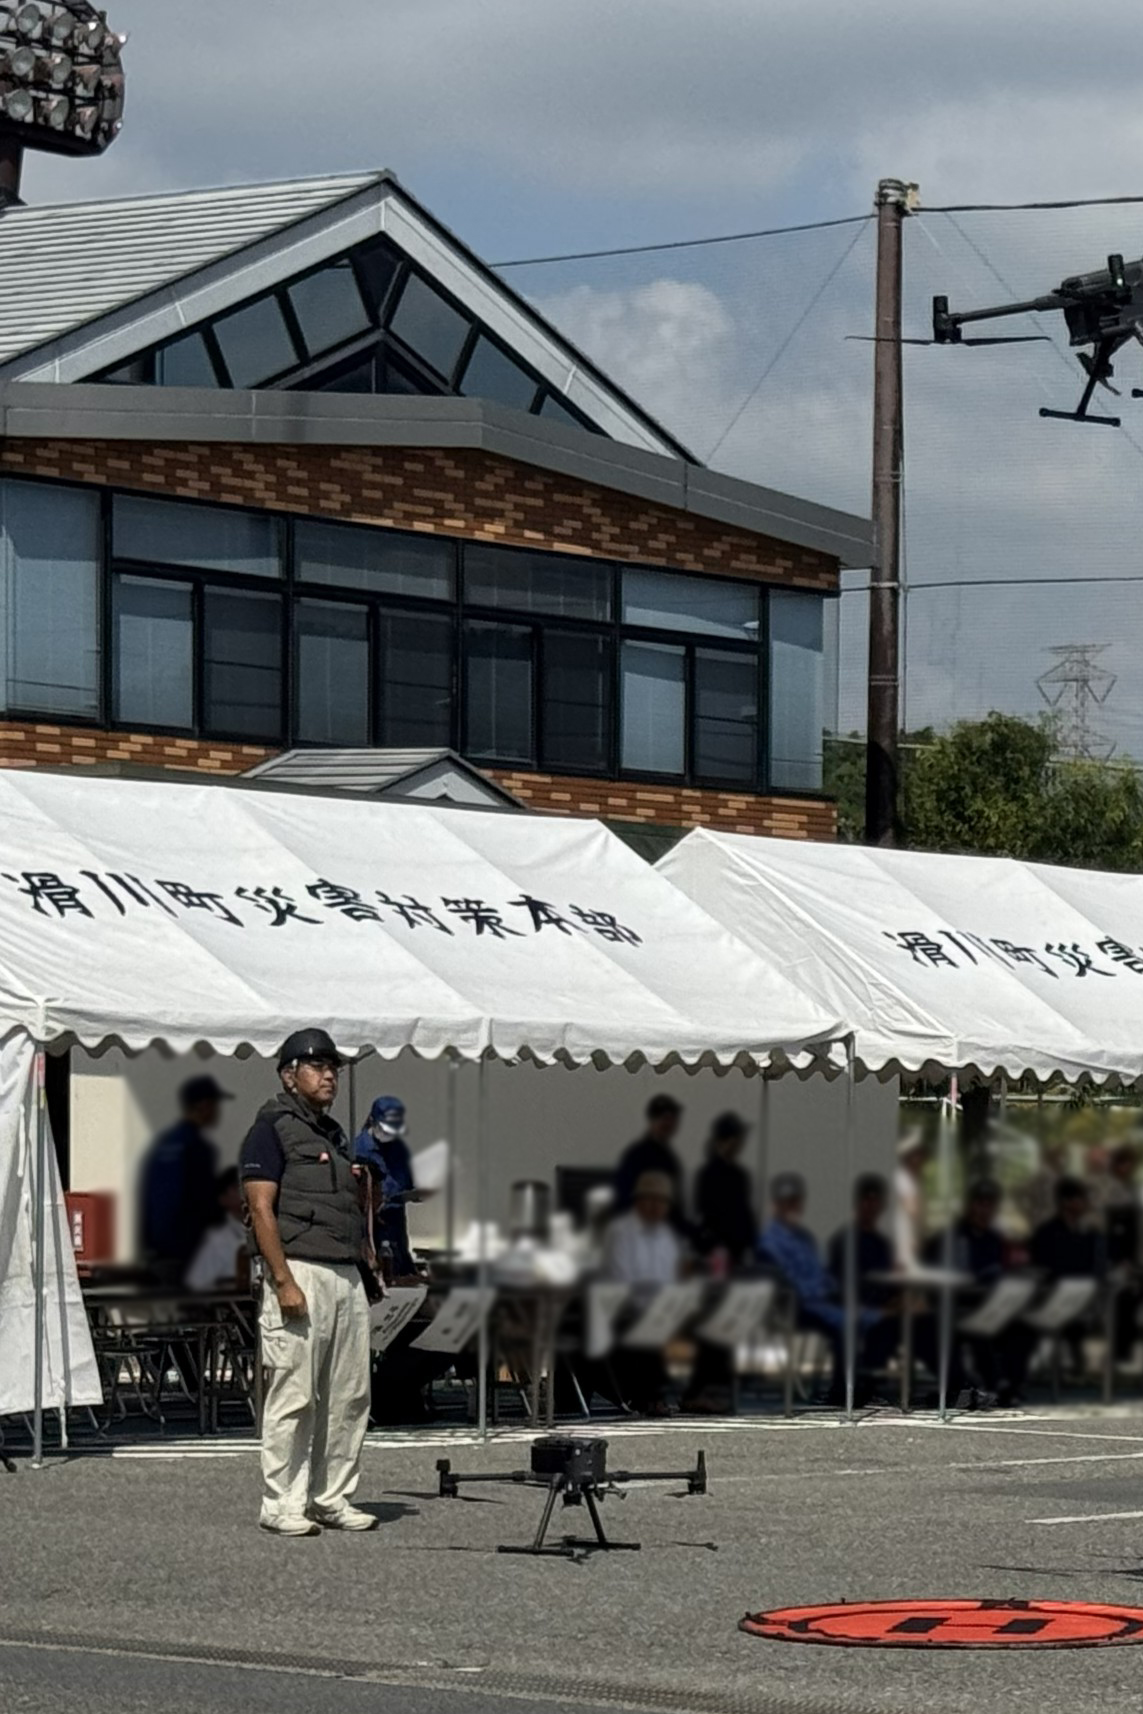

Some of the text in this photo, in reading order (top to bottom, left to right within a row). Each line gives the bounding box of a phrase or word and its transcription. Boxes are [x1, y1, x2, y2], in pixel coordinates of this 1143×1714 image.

[2, 870, 643, 947] 滑川町災害対策本部
